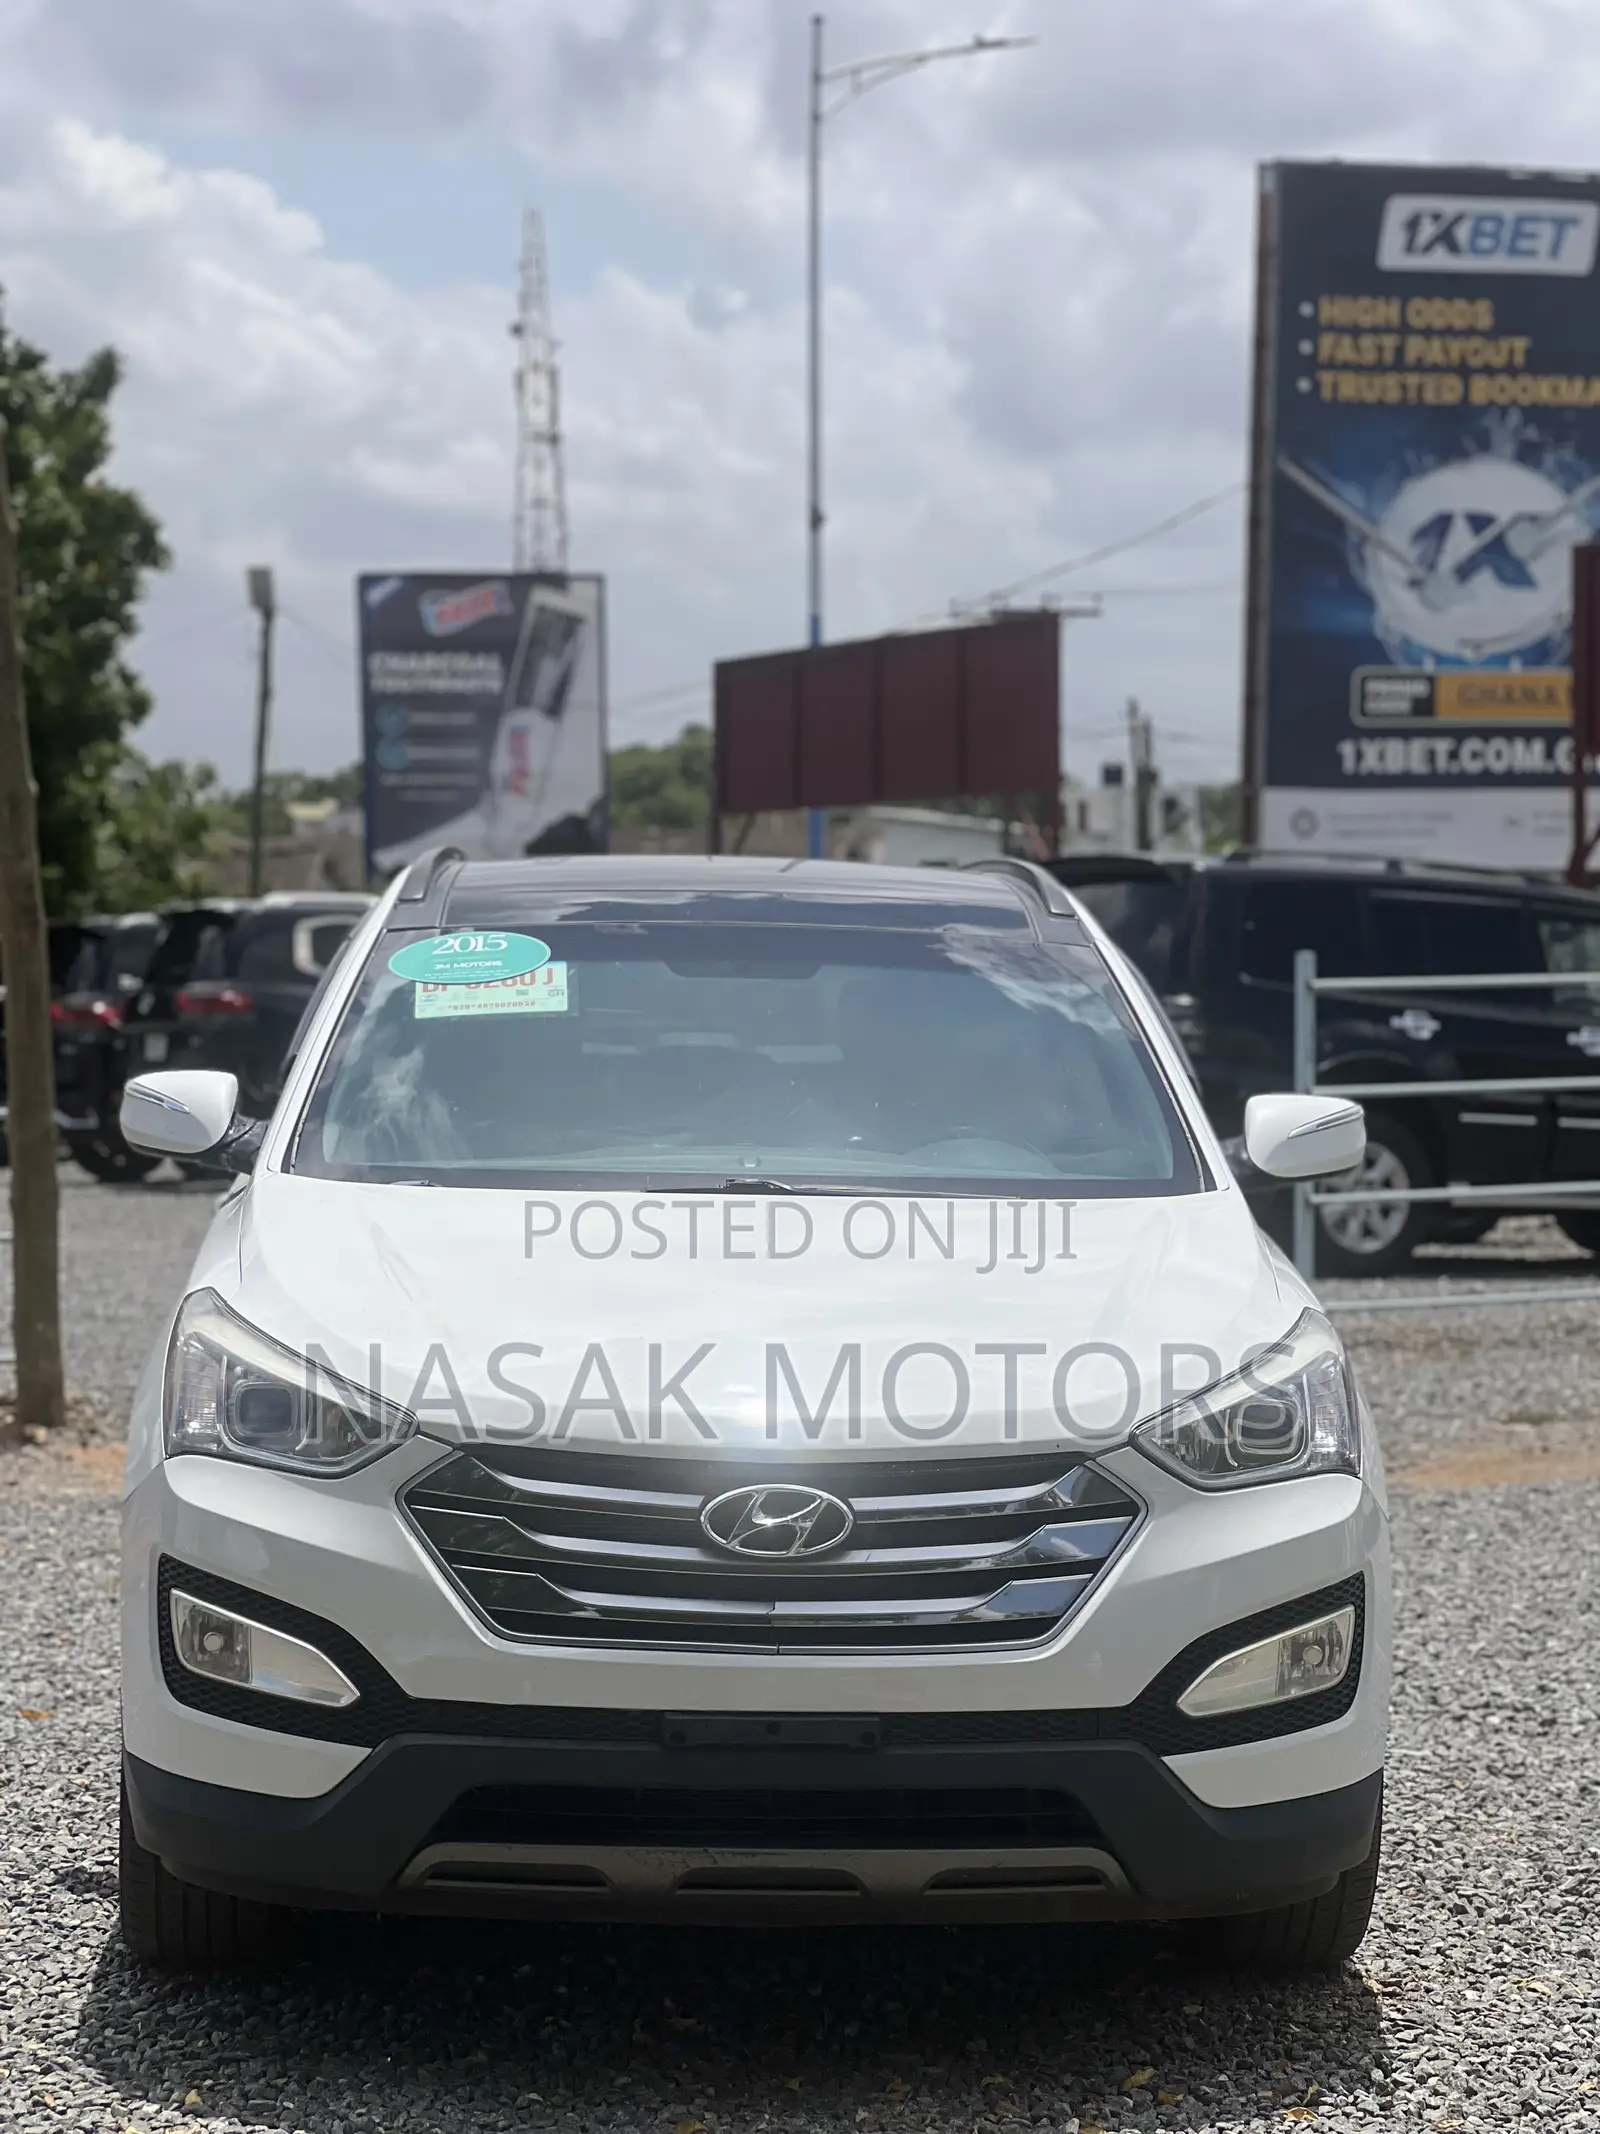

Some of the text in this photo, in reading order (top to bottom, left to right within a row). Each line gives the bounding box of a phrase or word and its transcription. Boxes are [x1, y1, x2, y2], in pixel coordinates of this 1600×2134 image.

[1402, 209, 1580, 259] 1XBET
[1317, 331, 1531, 368] FAST PAYOUT
[1316, 370, 1464, 405] TRUSTED
[432, 934, 508, 955] 2015
[453, 960, 503, 969] MOTORS
